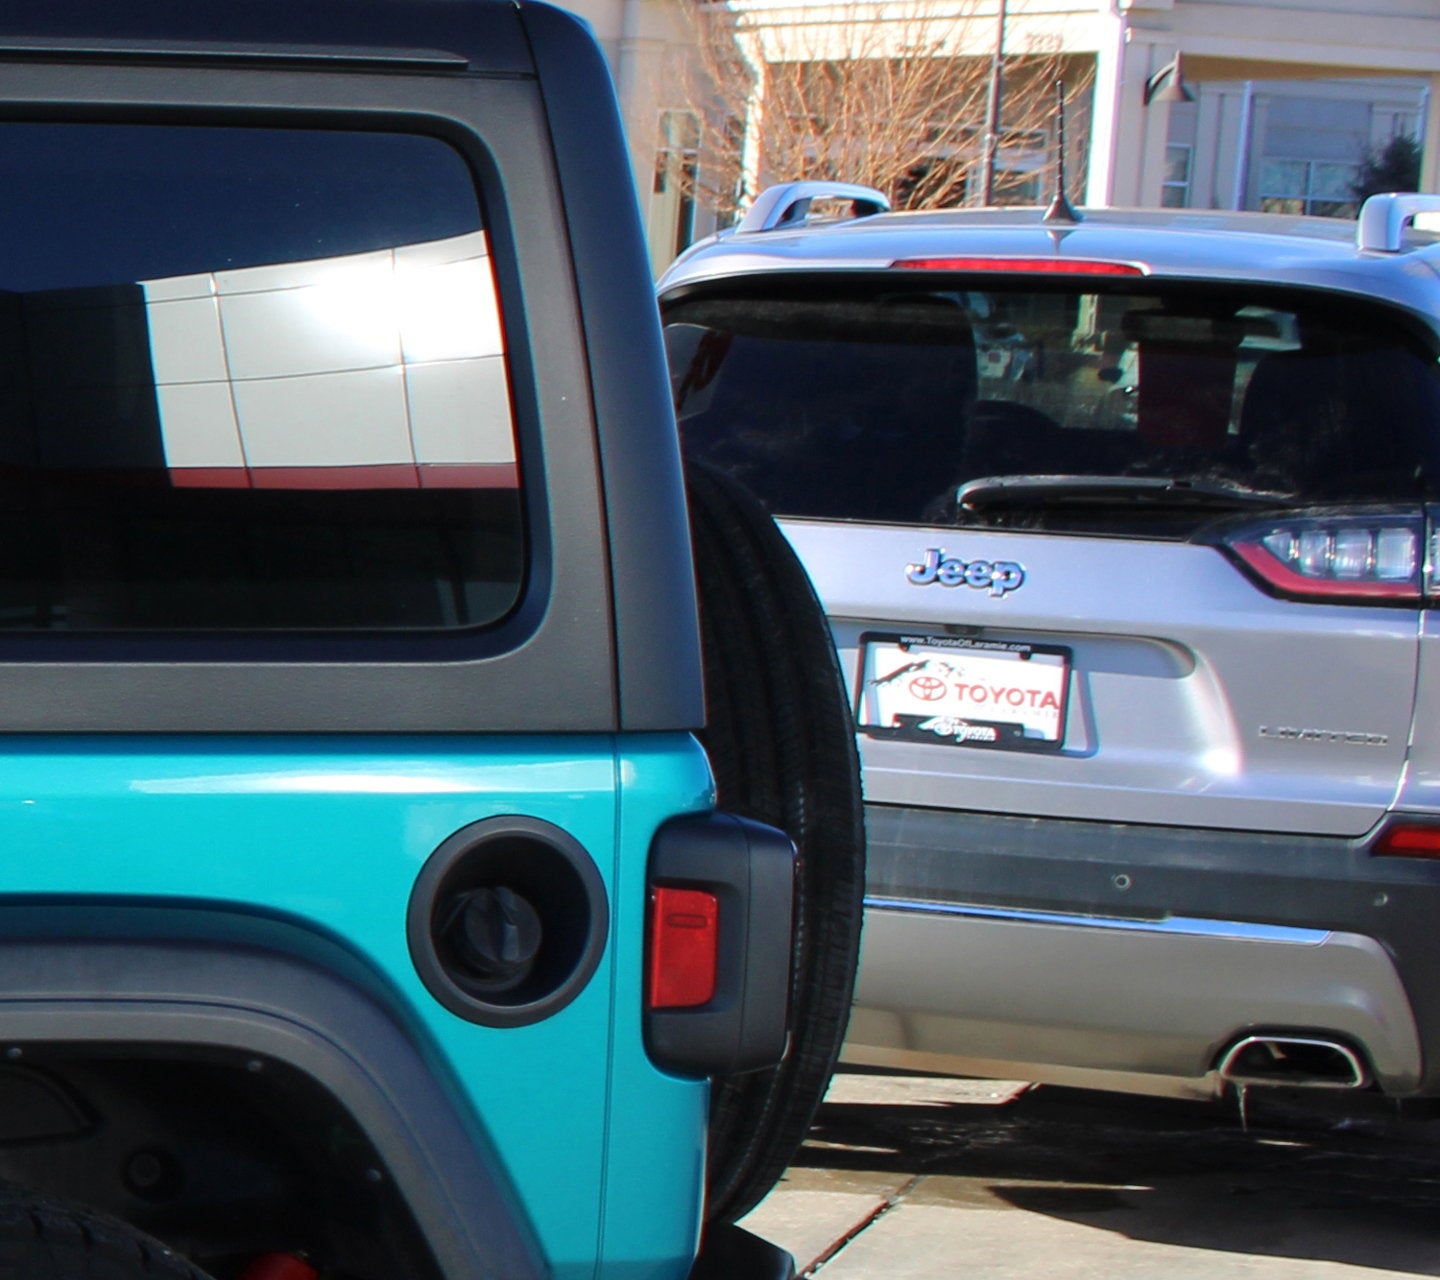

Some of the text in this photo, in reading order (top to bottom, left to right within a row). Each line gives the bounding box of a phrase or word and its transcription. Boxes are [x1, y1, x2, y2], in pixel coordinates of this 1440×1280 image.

[905, 548, 1026, 597] Jeep
[954, 683, 1060, 710] TOYOTA
[1259, 726, 1388, 746] LIMITED
